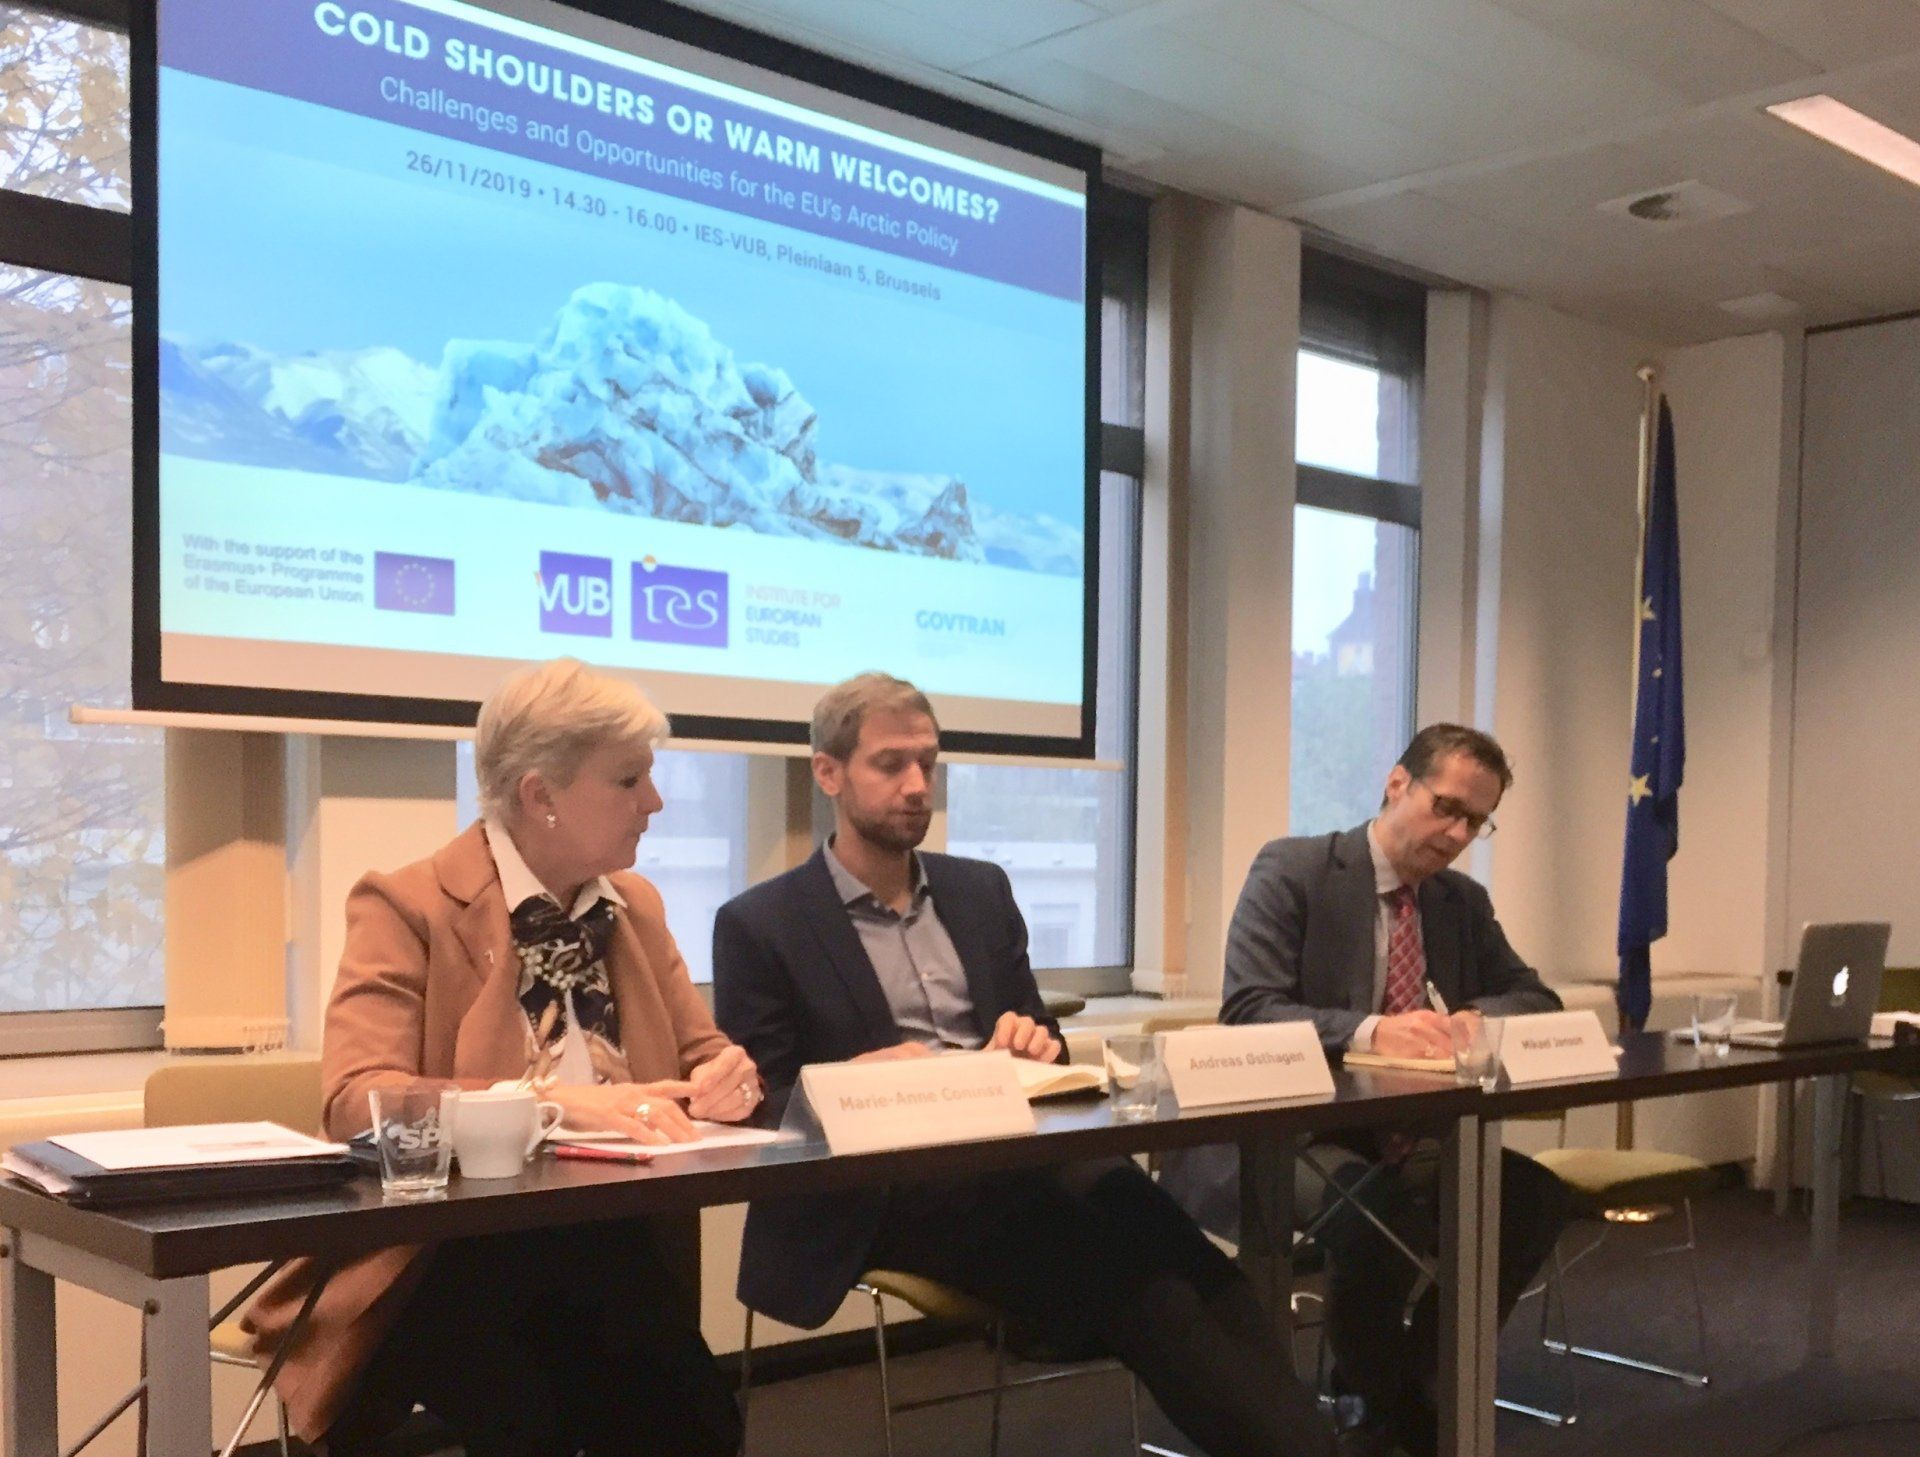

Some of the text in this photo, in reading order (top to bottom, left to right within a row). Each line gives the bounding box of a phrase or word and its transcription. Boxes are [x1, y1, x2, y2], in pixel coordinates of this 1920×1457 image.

[314, 2, 1001, 225] COLD SHOULDERS OR WARM WELCOMES?
[380, 76, 959, 257] Challenges and Opportunities for the EU's Arctic Policy
[406, 149, 531, 199] 26/11/2019
[552, 187, 606, 217] 14.30
[626, 205, 677, 236] 16.00
[776, 243, 852, 280] Pleinlaan
[875, 269, 941, 301] Brussels
[182, 533, 364, 565] With the support of the
[182, 553, 364, 584] Erasmus+ Programme
[184, 575, 364, 603] of the European Union
[534, 571, 610, 617] VUB
[745, 605, 822, 628] EUROPEAN
[745, 627, 800, 648] STUDIES
[1190, 1055, 1243, 1070] Andreas
[838, 1090, 937, 1111] Marie-Anne
